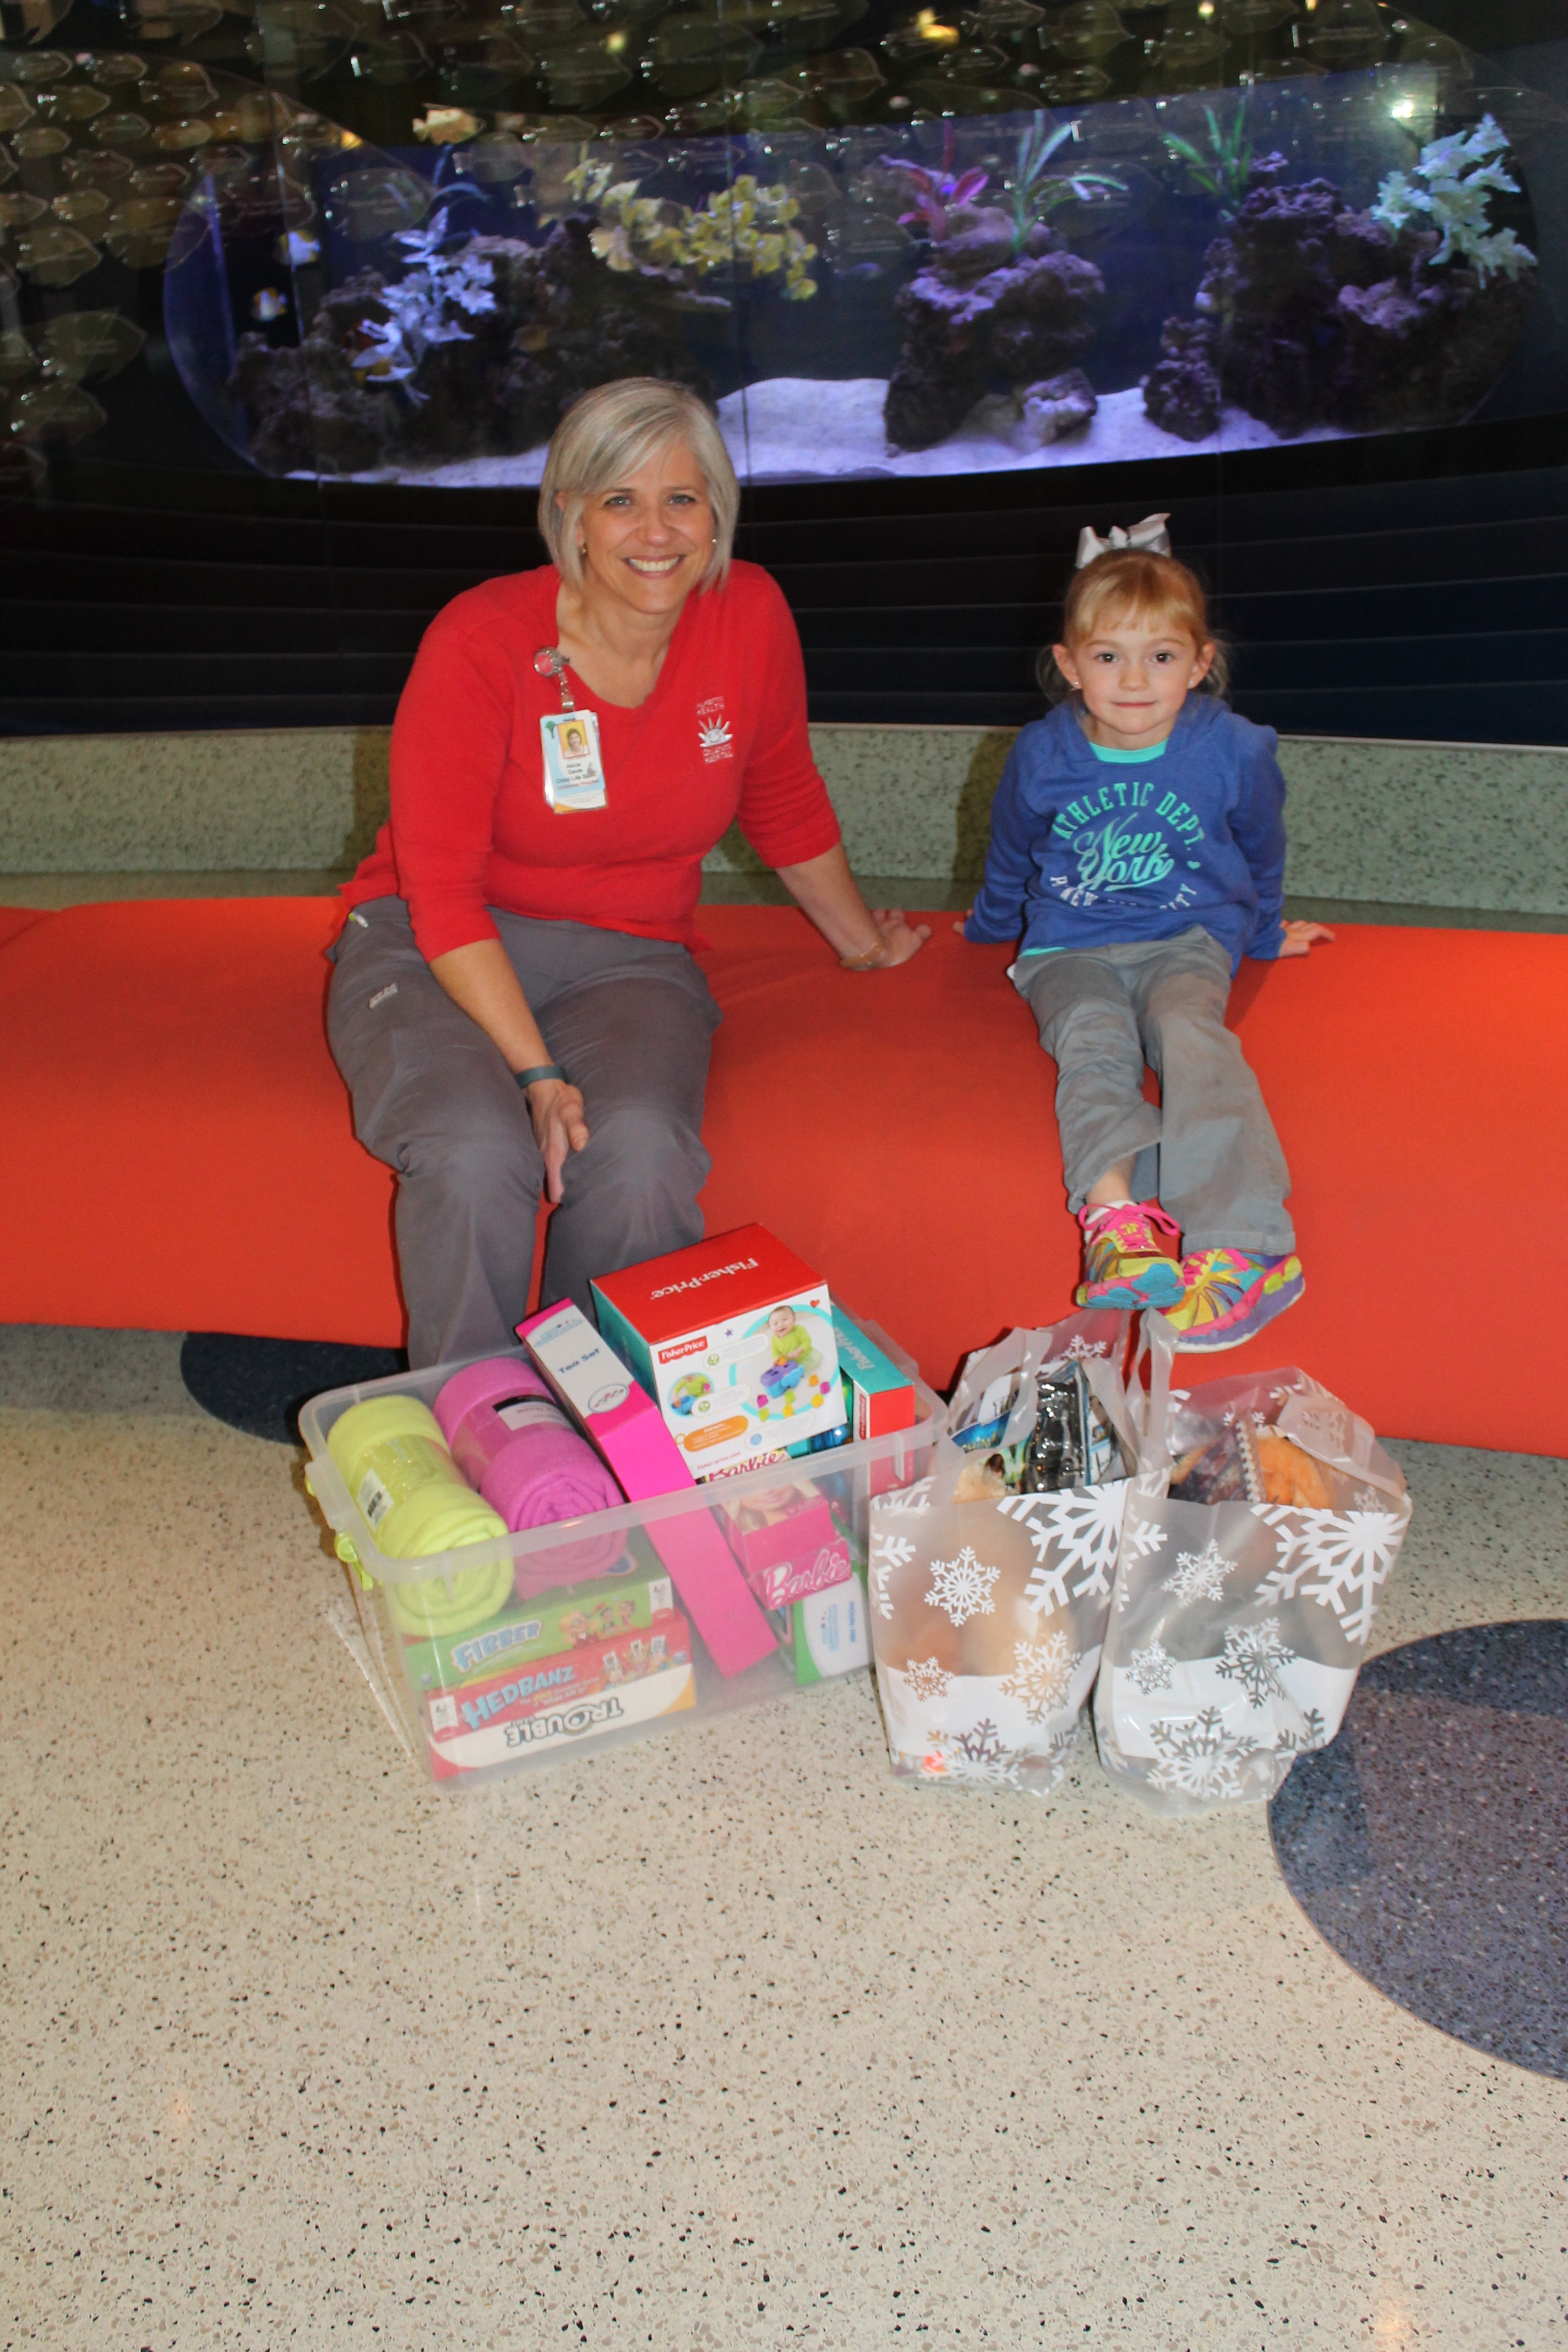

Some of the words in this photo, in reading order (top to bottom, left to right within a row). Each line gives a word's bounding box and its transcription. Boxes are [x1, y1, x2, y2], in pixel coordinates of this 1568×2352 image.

[1052, 781, 1155, 840] ATHLETIC
[1074, 812, 1162, 859] New
[1077, 843, 1174, 891] York
[651, 1258, 759, 1299] Fisher-Price
[557, 1359, 580, 1374] Tea
[580, 1348, 600, 1362] Set
[661, 1340, 705, 1360] Fisher-Price
[766, 1548, 851, 1604] Barbie
[450, 1620, 542, 1674] FIBBER
[459, 1665, 577, 1732] HEDBANZ
[506, 1696, 624, 1748] TROUBLE
